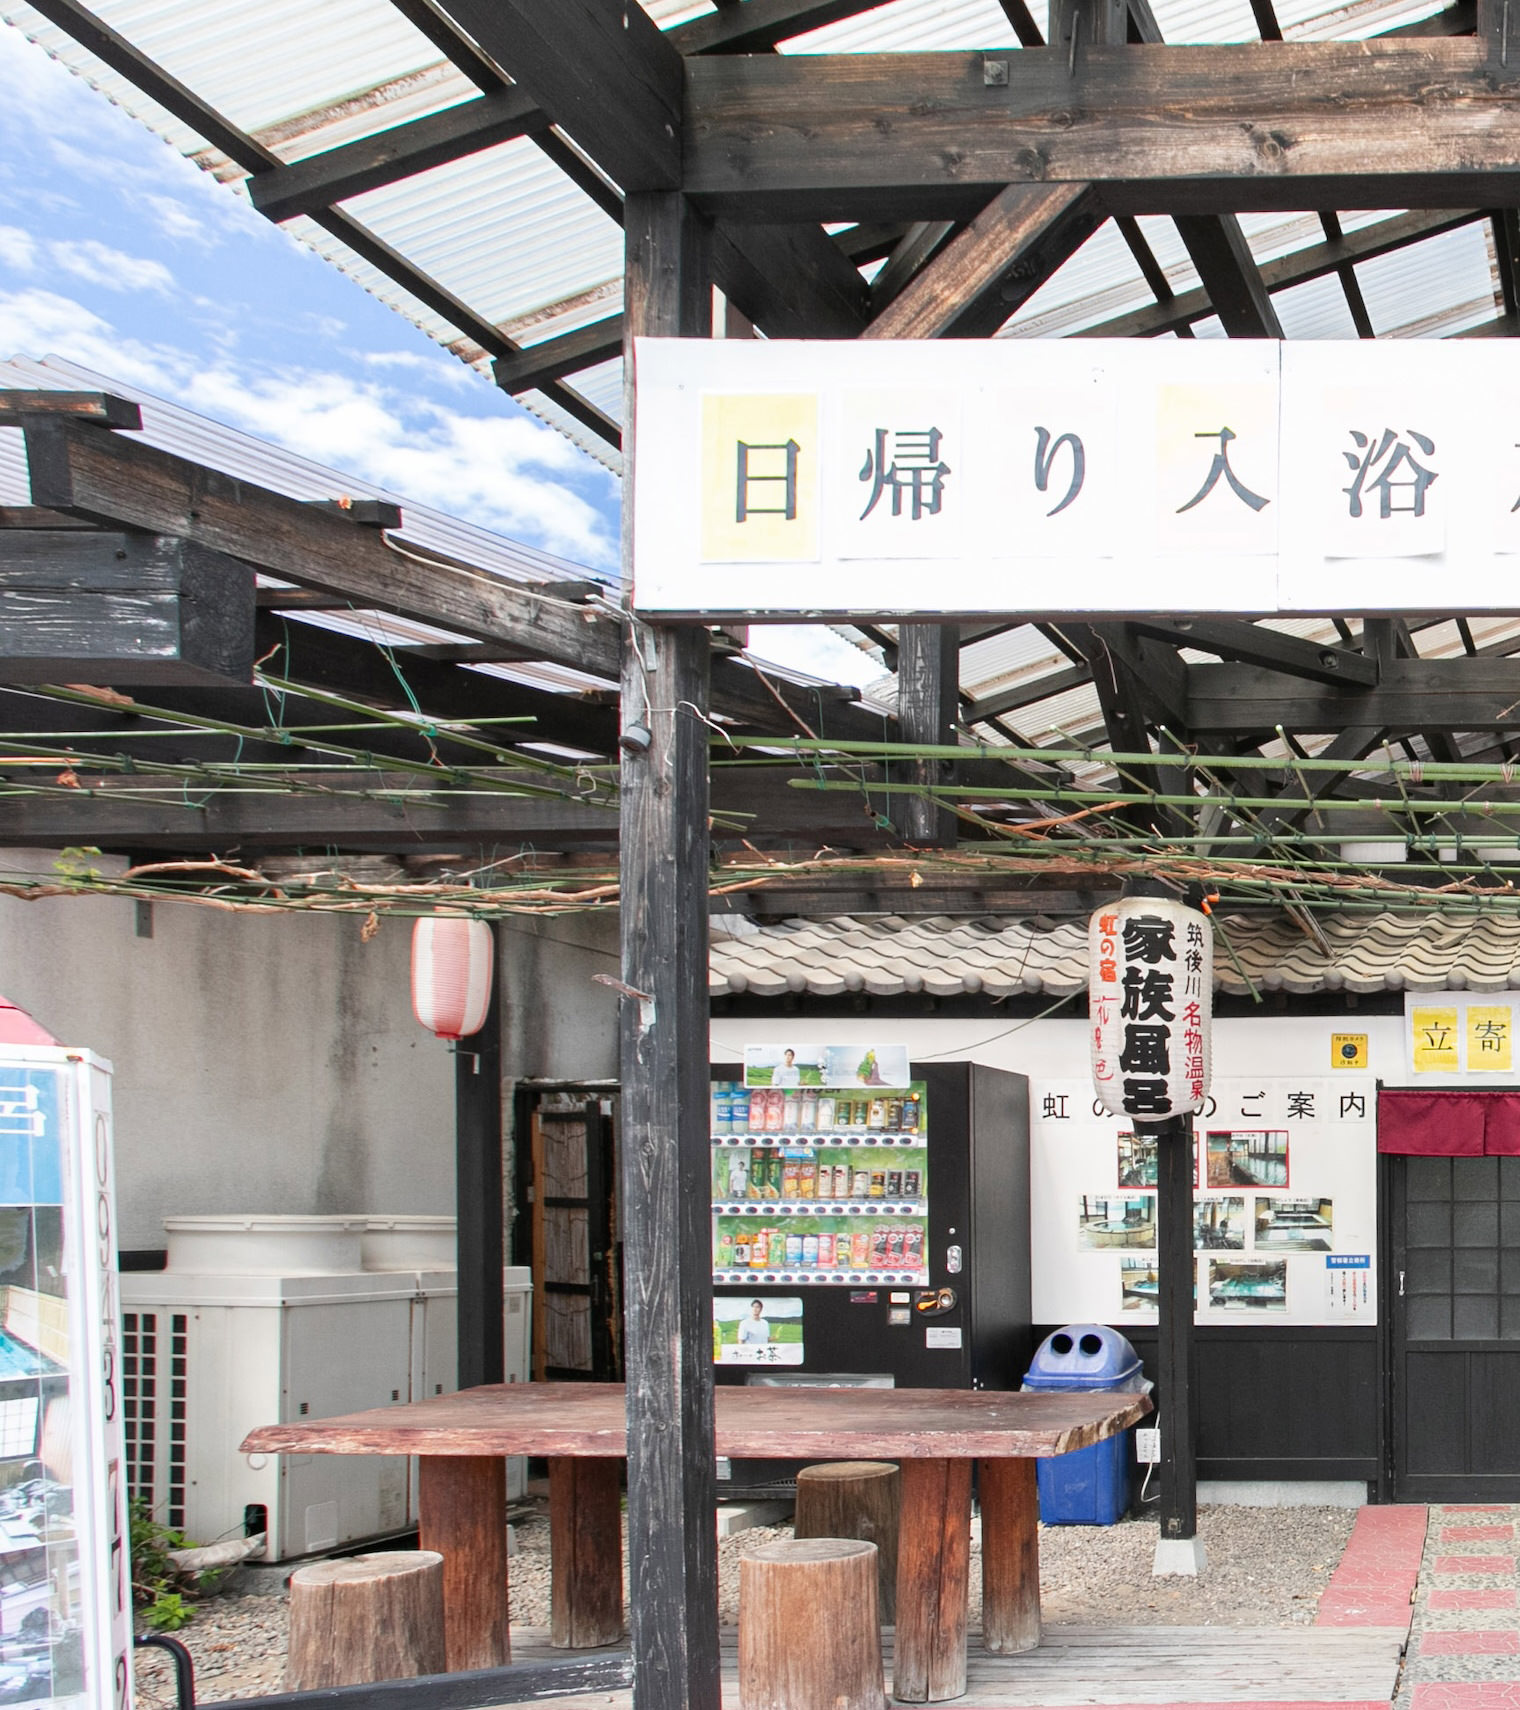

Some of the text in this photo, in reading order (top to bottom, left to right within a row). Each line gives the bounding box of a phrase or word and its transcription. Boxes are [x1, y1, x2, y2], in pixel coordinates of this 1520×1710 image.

[1099, 913, 1119, 983] 虹の宿
[1118, 914, 1177, 1115] 家族風呂
[1182, 921, 1205, 1101] 筑後川 名物温泉
